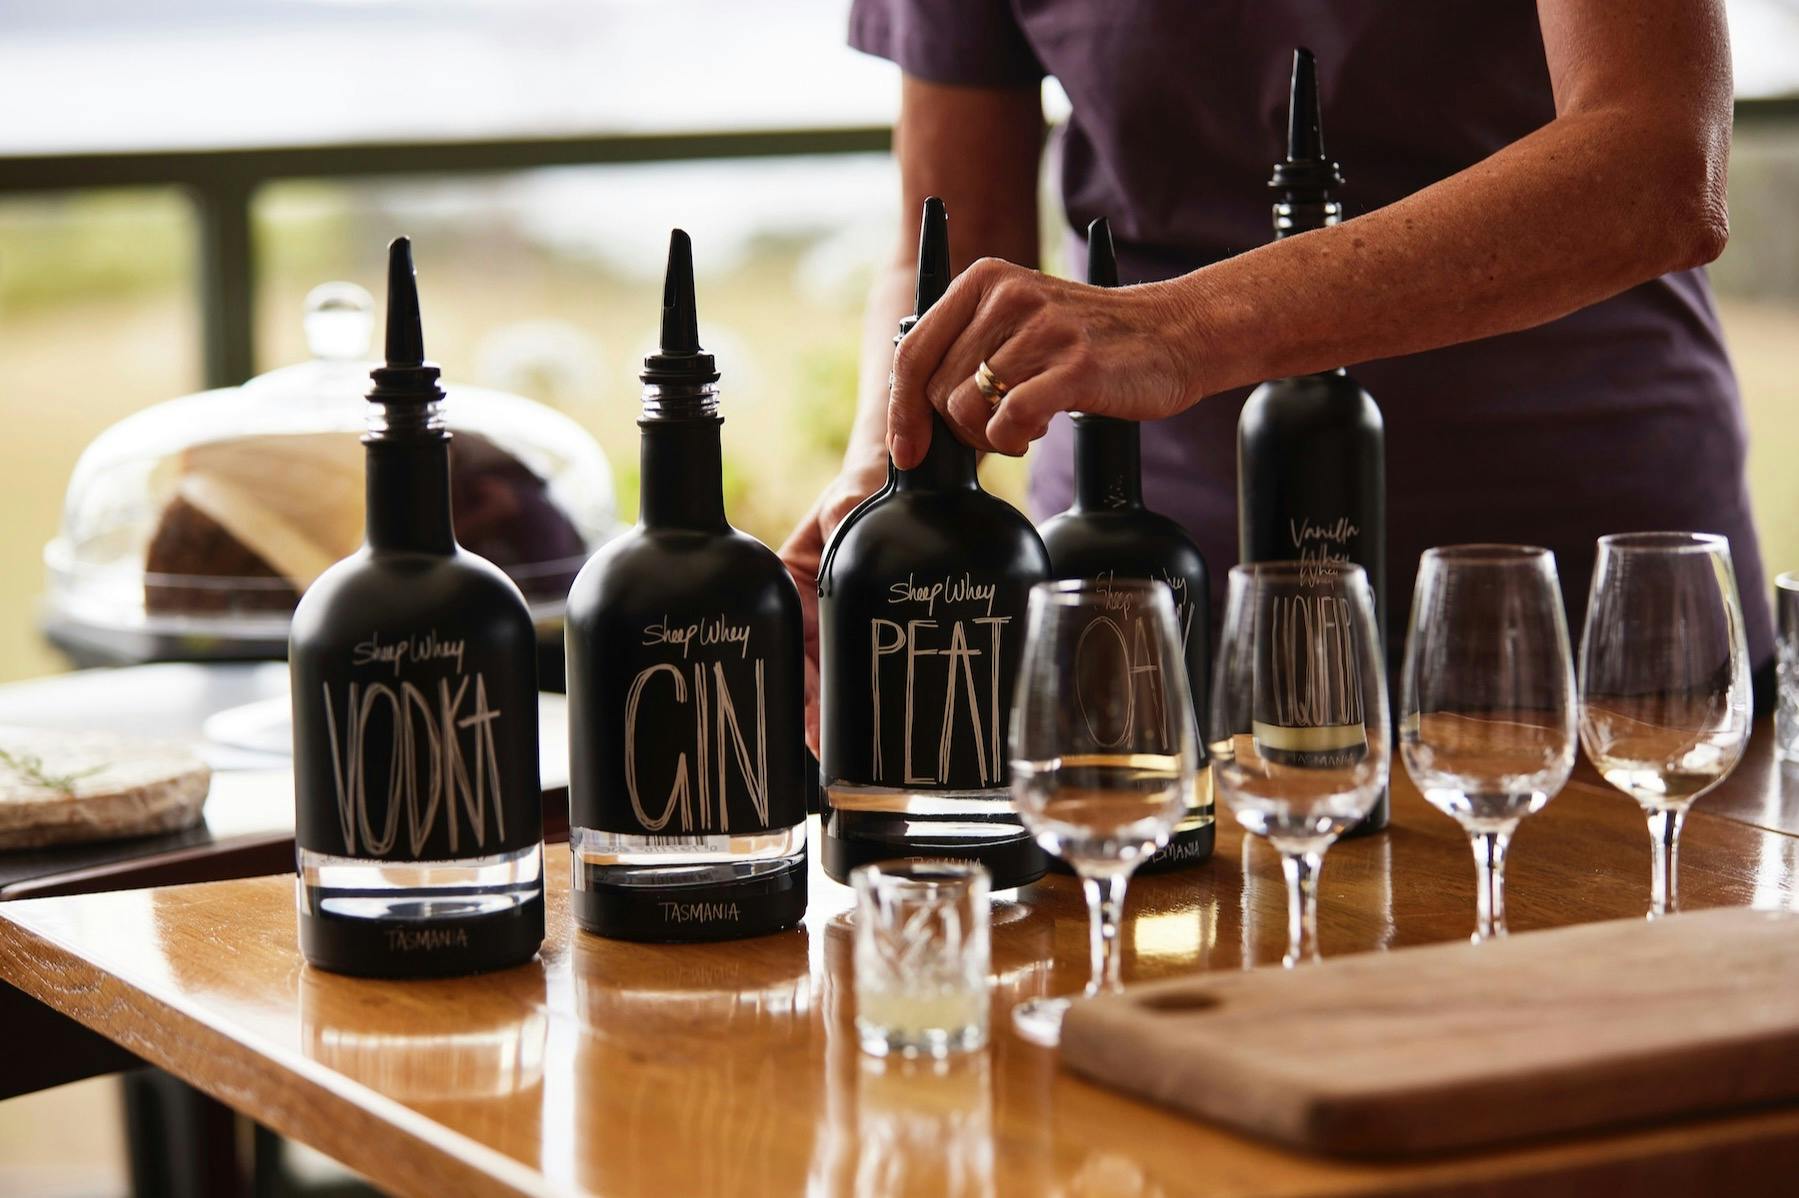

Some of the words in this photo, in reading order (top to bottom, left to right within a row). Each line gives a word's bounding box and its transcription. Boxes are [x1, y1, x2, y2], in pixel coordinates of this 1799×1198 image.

[1290, 516, 1360, 548] Vanilla
[888, 572, 943, 617] Sheep
[945, 575, 997, 617] Whey
[352, 632, 409, 677] Sheep
[410, 629, 465, 675] Whey
[642, 615, 698, 659] Sheep
[699, 616, 750, 659] Whey
[871, 615, 1013, 788] PEAT
[323, 672, 506, 859] VODKA
[625, 658, 769, 832] GIN
[658, 897, 740, 923] TASMANIA
[384, 925, 468, 953] TASMANIA
